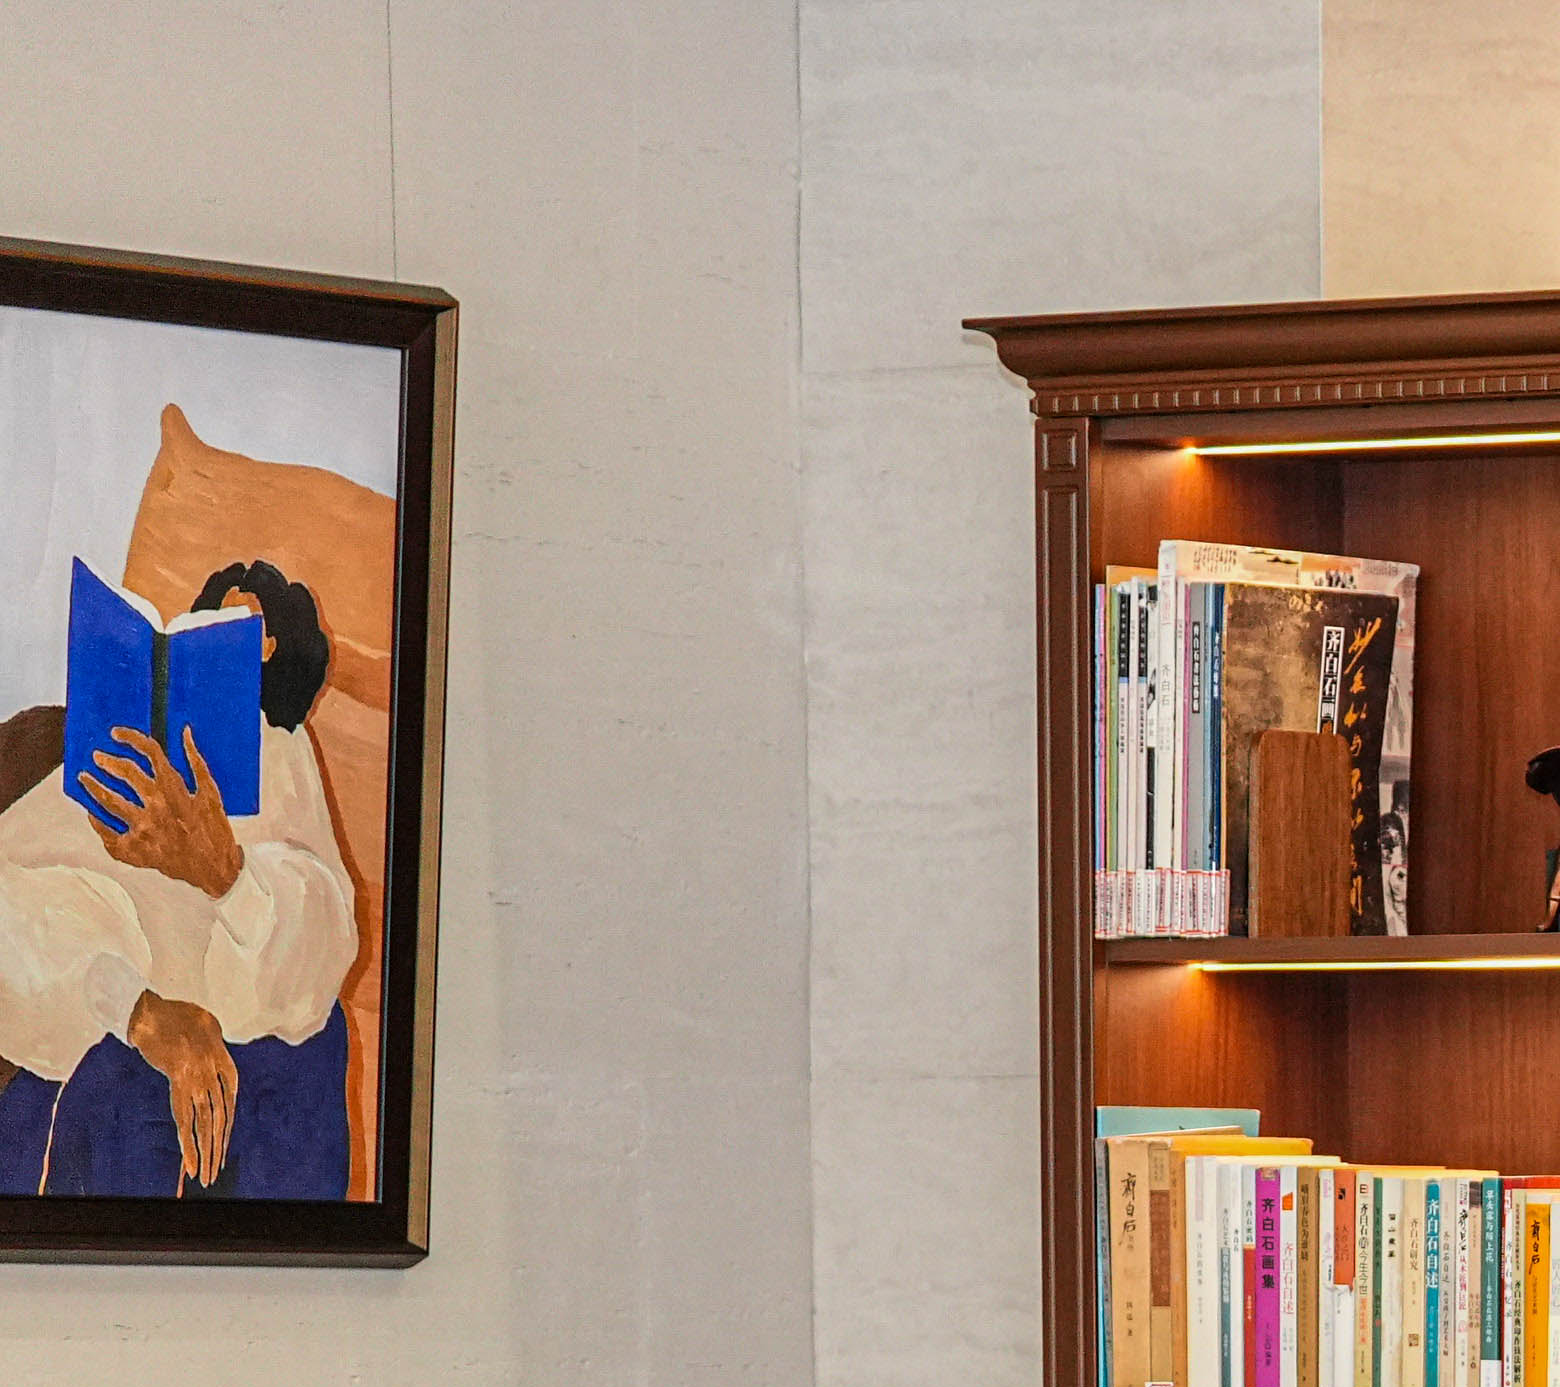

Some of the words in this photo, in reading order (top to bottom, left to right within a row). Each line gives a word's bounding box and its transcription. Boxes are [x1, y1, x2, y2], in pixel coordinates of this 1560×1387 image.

[1261, 1197, 1276, 1290] 齐白石画集
[1281, 1242, 1295, 1316] 齐白石自述
[1425, 1197, 1440, 1290] 齐白石自述
